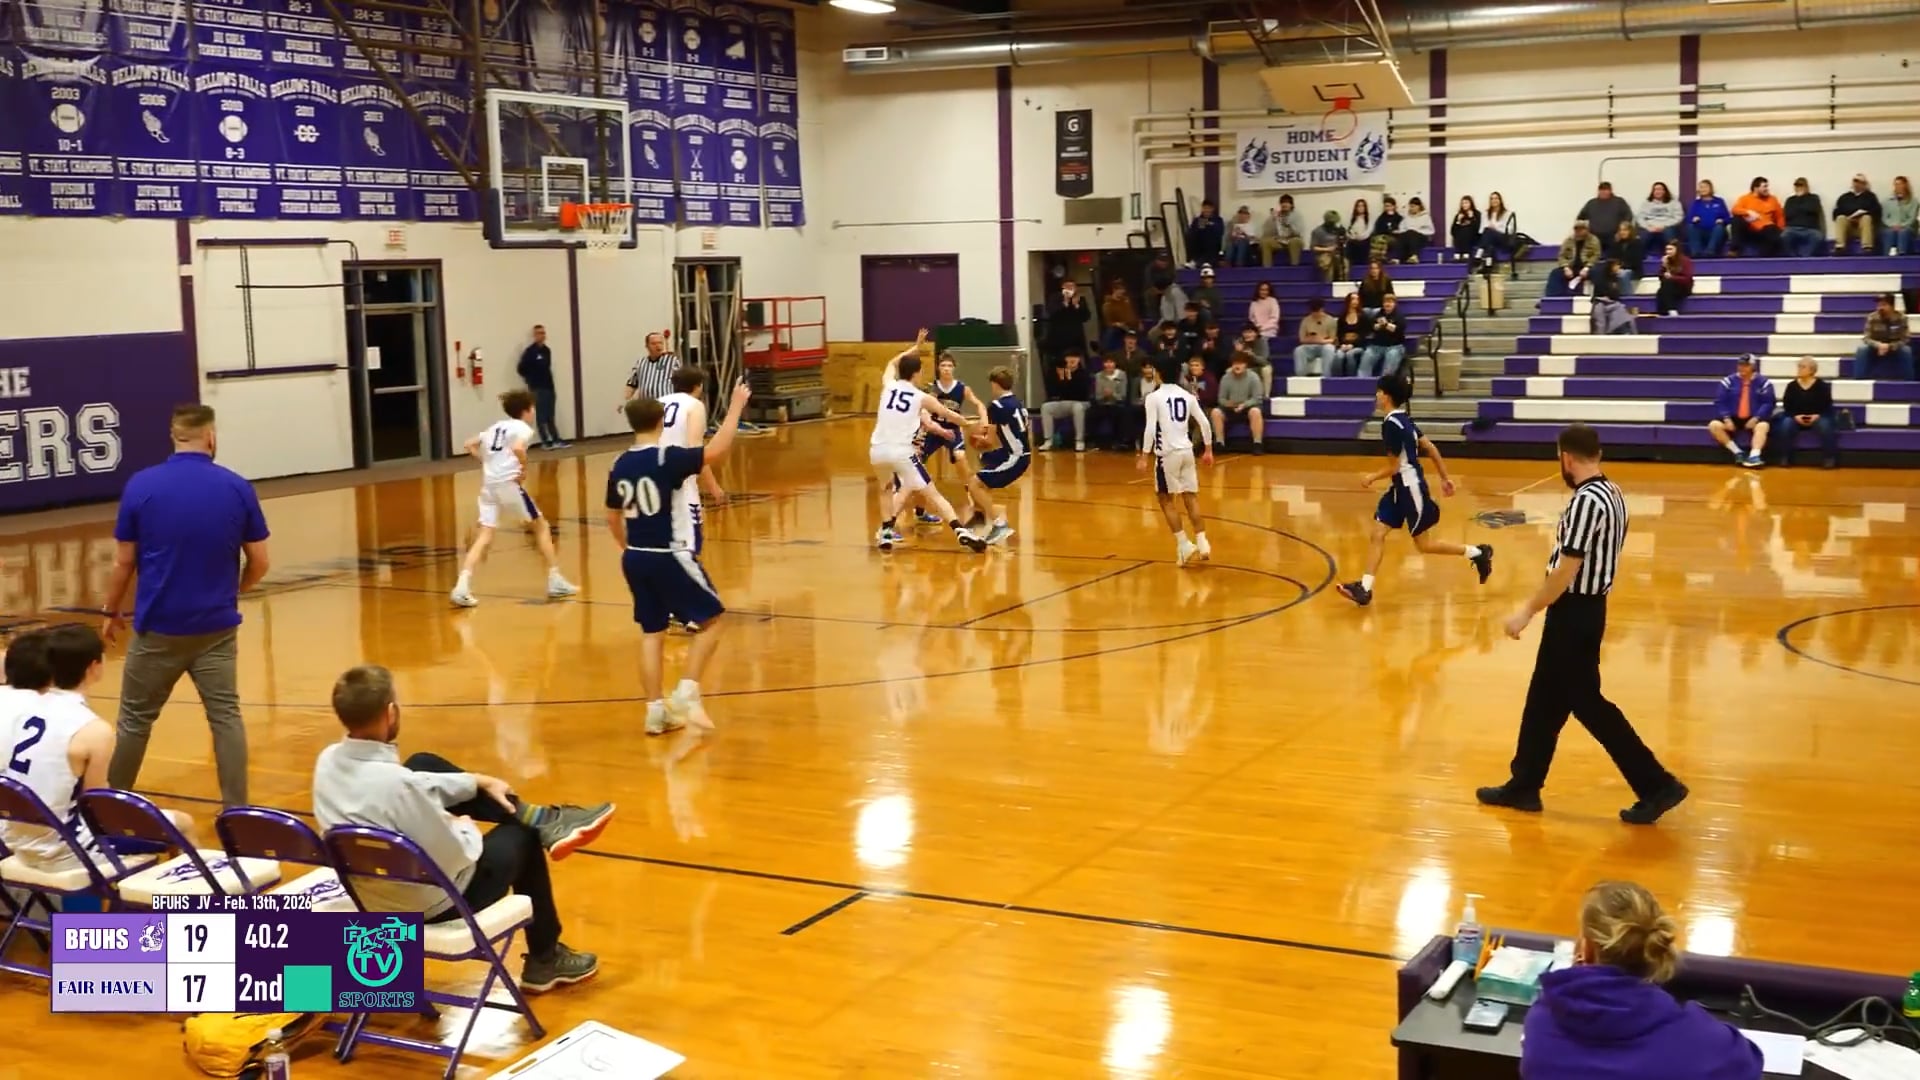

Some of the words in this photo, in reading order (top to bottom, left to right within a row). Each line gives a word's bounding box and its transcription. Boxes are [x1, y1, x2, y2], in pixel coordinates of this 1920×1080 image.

[112, 64, 158, 87] BELLOWS
[159, 67, 191, 92] FALLS
[195, 72, 238, 93] BELLOWS
[238, 73, 267, 98] FALLS
[51, 87, 80, 100] 2003
[270, 79, 310, 98] BELLOWS
[310, 80, 338, 103] FALLS
[340, 85, 378, 105] BELLOWS
[139, 93, 166, 107] 2006
[1068, 118, 1079, 132] G
[1287, 129, 1336, 144] HOME
[58, 139, 83, 151] 10-1
[1271, 148, 1351, 165] STUDENT
[1275, 168, 1348, 184] SECTION
[52, 197, 95, 210] FOOTBALL
[135, 199, 156, 211] BOYS
[157, 200, 183, 212] TRACK
[219, 201, 255, 213] FOOTBALL
[886, 389, 914, 413] 15
[1166, 397, 1187, 422] 10
[616, 476, 661, 519] 20
[9, 716, 46, 775] 2
